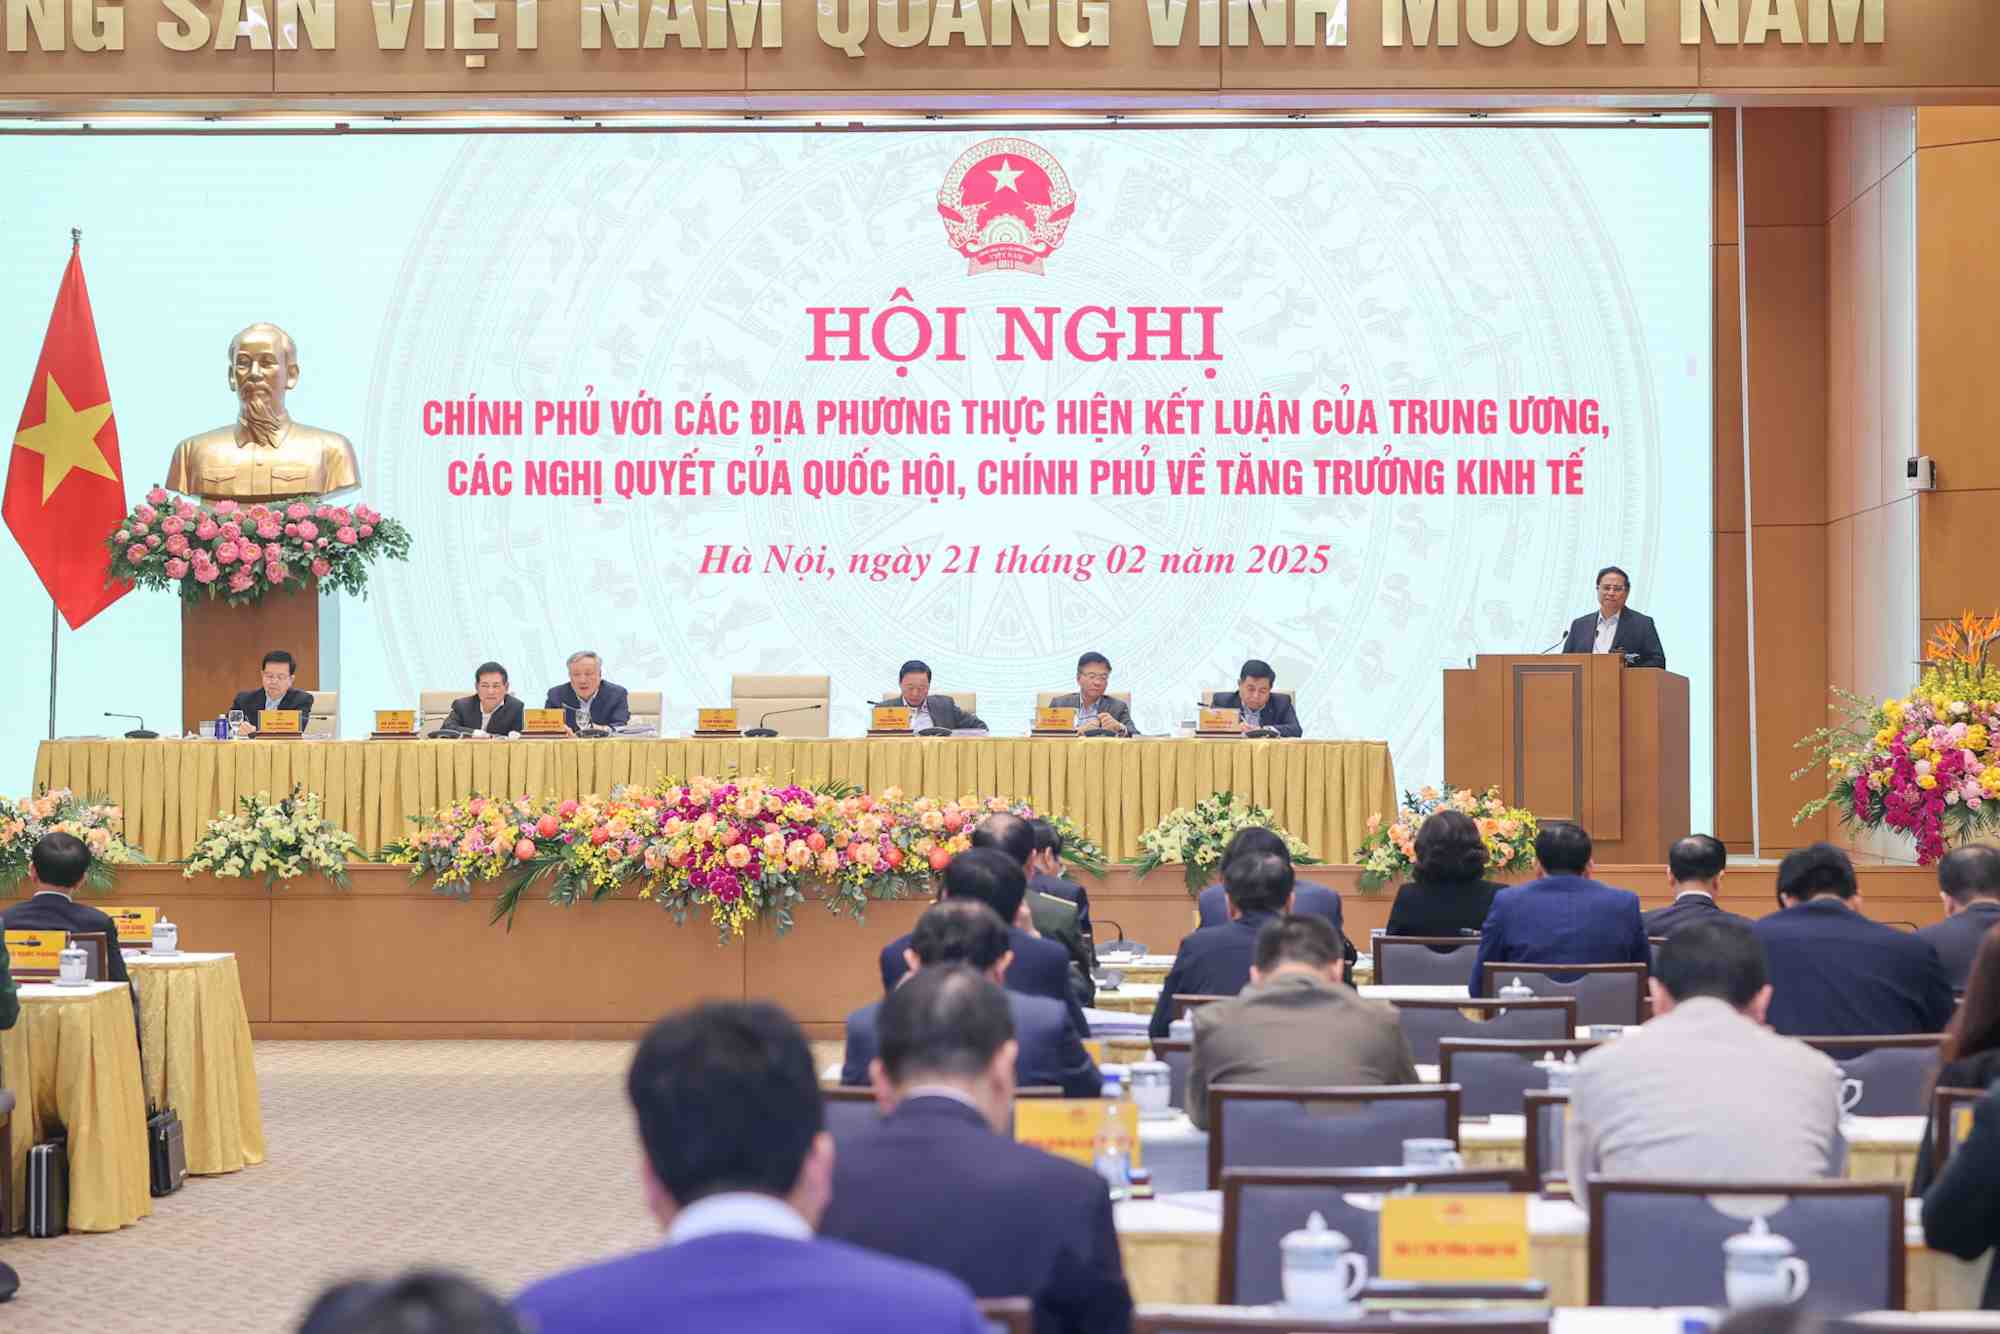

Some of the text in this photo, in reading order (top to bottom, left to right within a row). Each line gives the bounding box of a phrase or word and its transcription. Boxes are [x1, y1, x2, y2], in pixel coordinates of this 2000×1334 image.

[805, 287, 1224, 380] HỘI NGHỊ
[423, 384, 1609, 443] CHÍNH PHỦ VỚI CÁC ĐỊA PHƯƠNG THỰC HIỆN KẾT LUẬN CỦA TRUNG ƯƠNG,
[448, 444, 1587, 504] CÁC NGHỊ QUYẾT CỦA QUỐC HỘI, CHÍNH PHỦ VỀ TĂNG TRƯỞNG KINH TẾ
[698, 544, 1332, 582] Hà Nội, ngày 21 tháng 02 năm 2025
